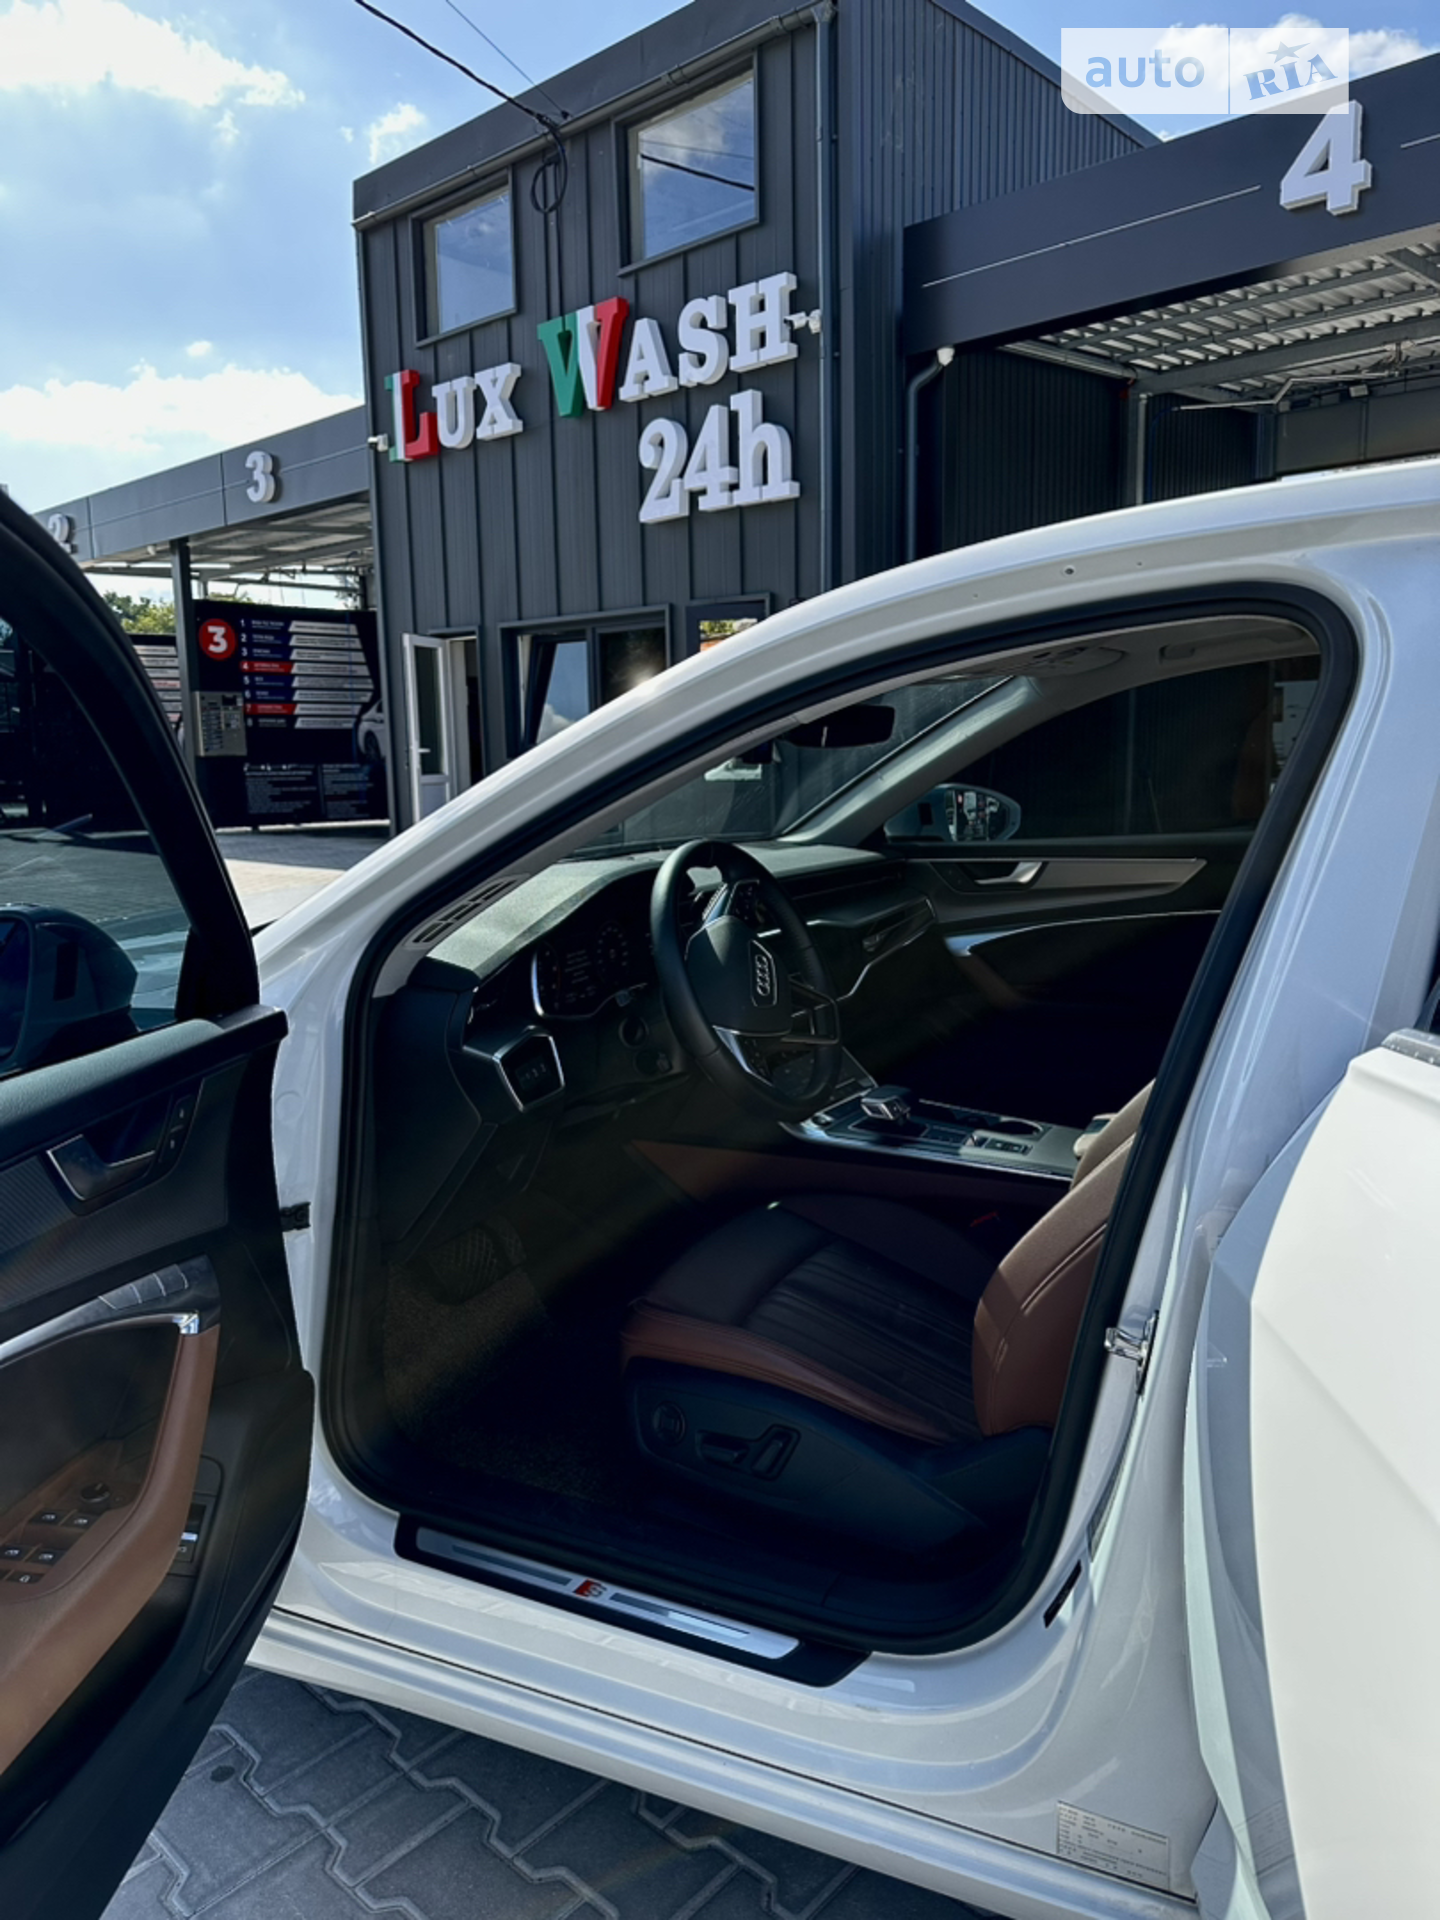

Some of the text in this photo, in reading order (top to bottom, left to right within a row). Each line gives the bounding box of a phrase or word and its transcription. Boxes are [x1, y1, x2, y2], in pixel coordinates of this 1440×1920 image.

[1279, 100, 1372, 216] 4
[245, 450, 276, 503] 3
[638, 388, 800, 524] 24h
[207, 625, 229, 654] 3
